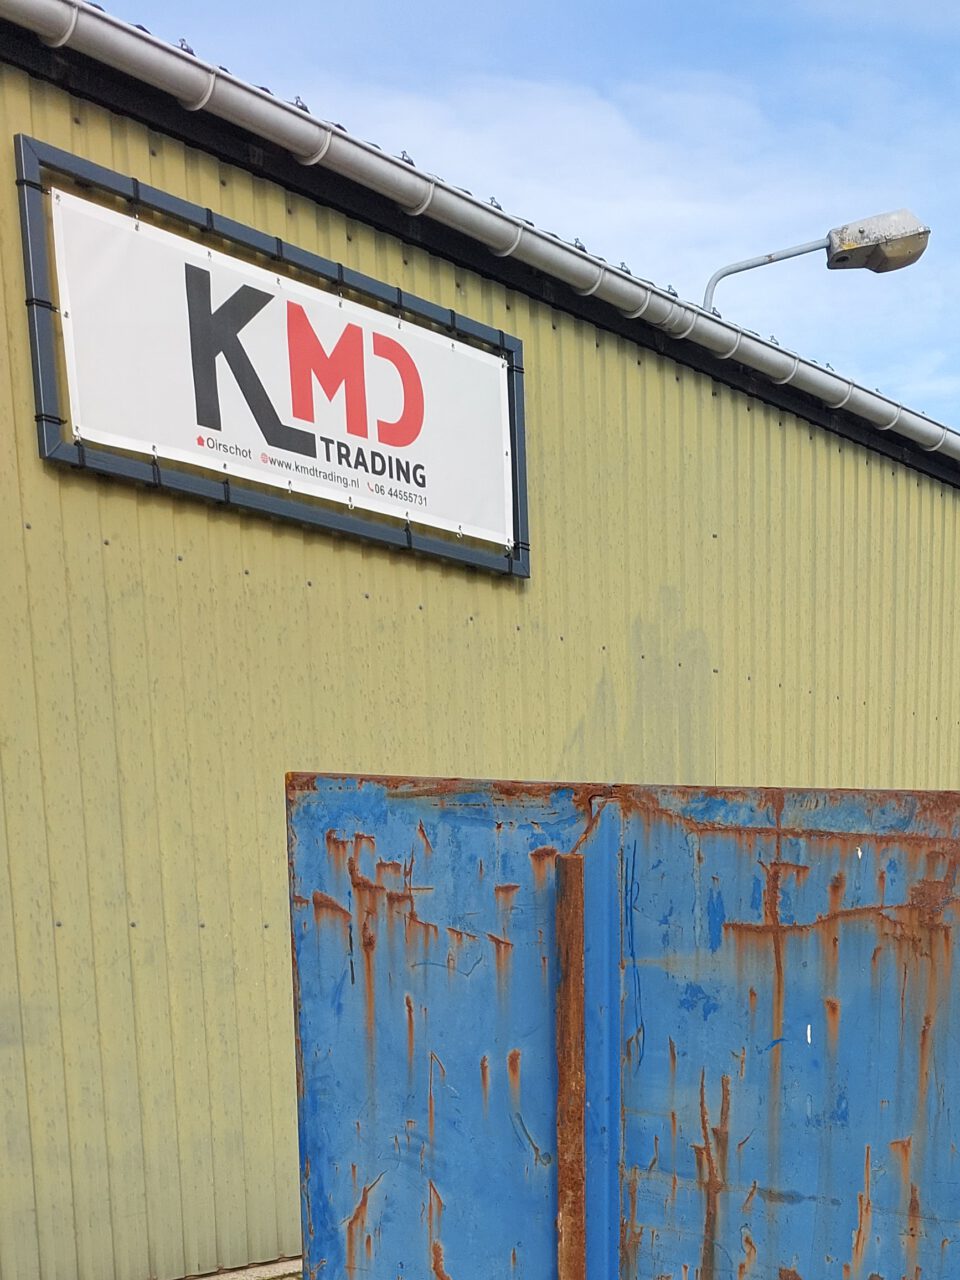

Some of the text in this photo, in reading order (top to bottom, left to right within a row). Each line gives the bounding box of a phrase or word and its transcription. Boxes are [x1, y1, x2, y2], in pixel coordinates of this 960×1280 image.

[184, 262, 425, 458] KMD
[206, 437, 428, 507] Oirschot www.kmdtrading.nl 06 44555731
[320, 436, 427, 488] TRADING
